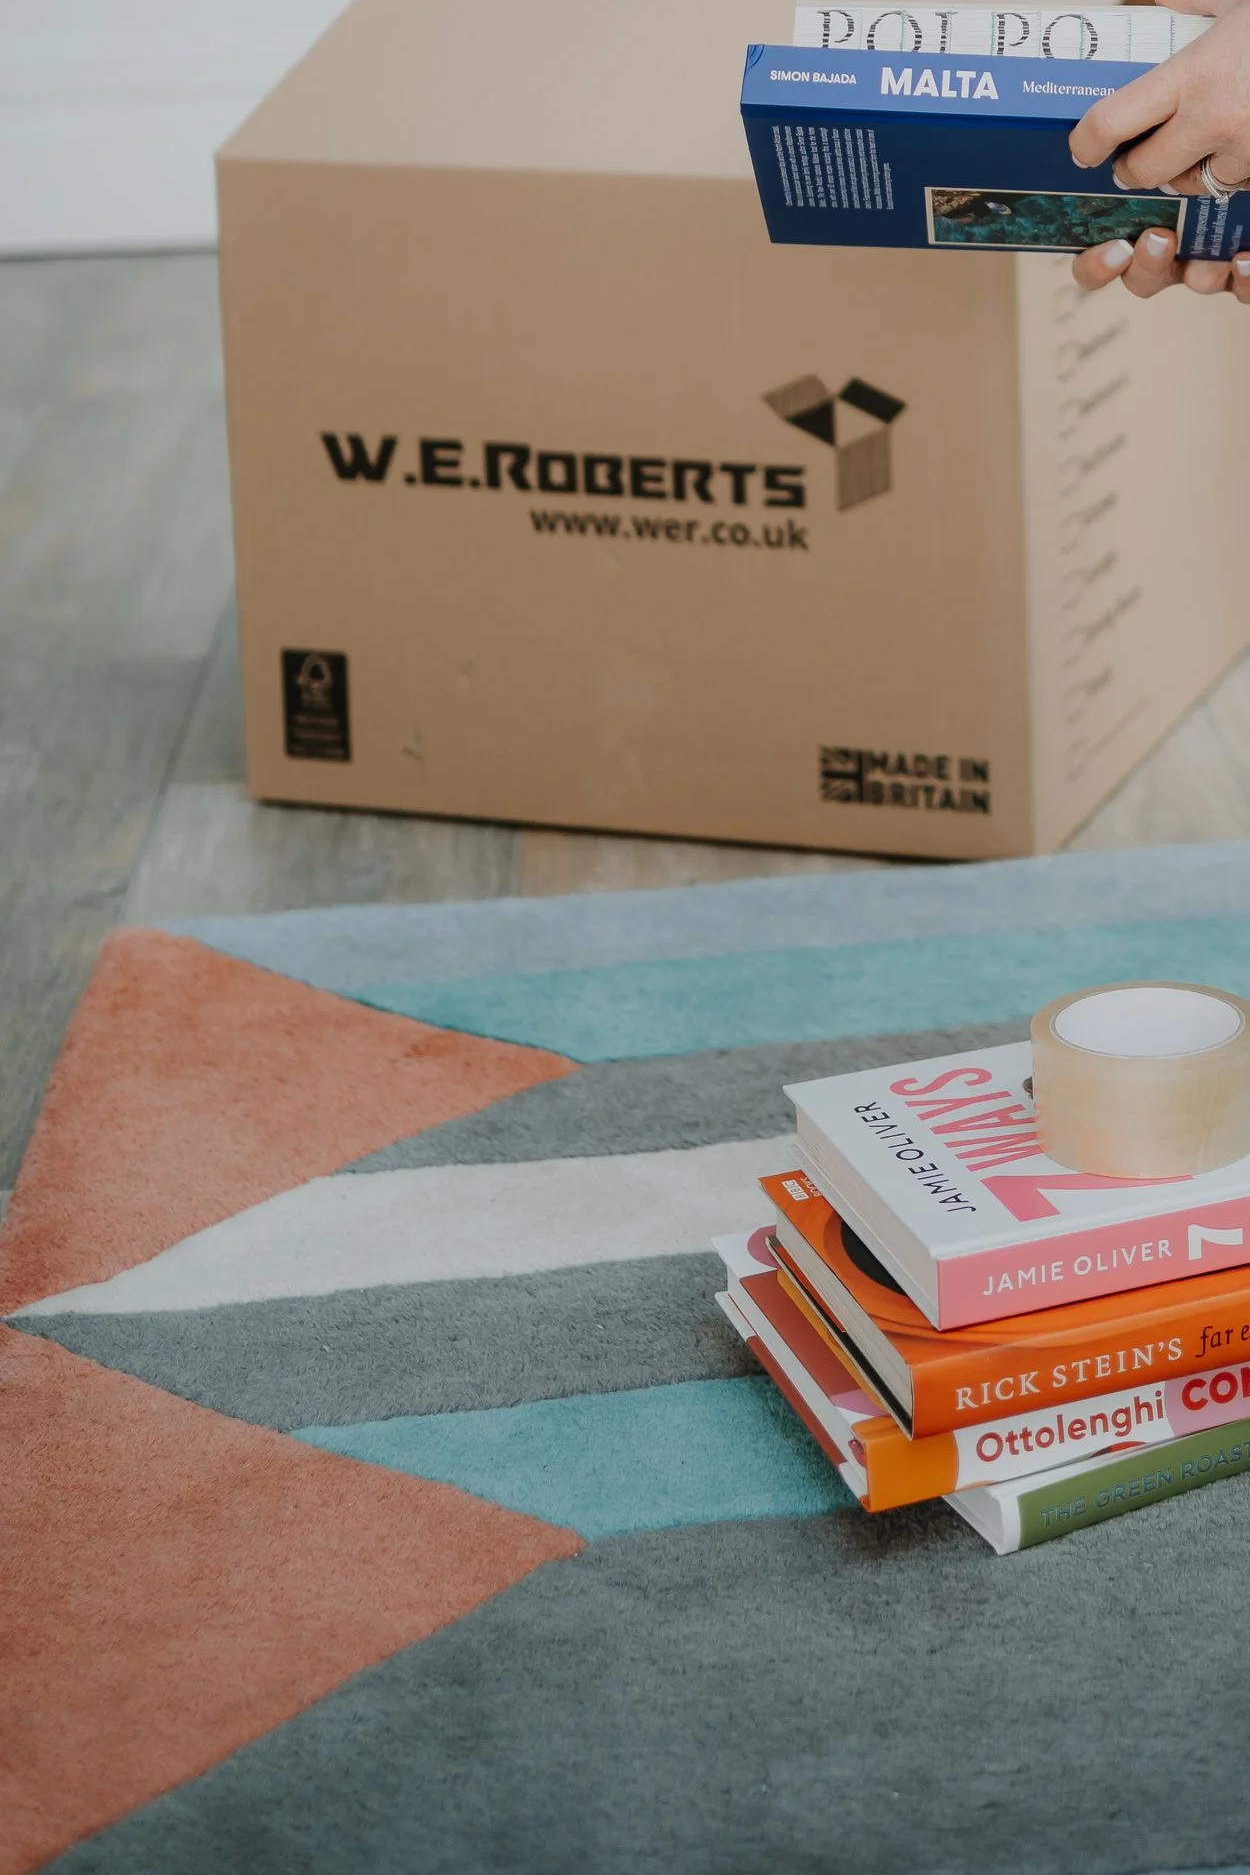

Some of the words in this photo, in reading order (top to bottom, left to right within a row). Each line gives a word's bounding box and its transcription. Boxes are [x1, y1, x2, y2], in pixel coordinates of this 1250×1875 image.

[770, 69, 809, 82] SIMON
[813, 72, 857, 85] BAJADA
[880, 66, 999, 100] MALTA
[1023, 80, 1115, 97] Mediterranean
[320, 431, 806, 509] W.E.ROBERTS
[529, 508, 810, 551] www.wer.co.uk
[862, 749, 950, 780] MADE
[959, 757, 989, 783] IN
[862, 780, 991, 815] BRITAIN
[855, 1101, 924, 1161] OLIVER
[889, 1067, 1043, 1173] WAYS
[781, 1179, 809, 1201] BBC
[909, 1161, 976, 1213] JAMIE
[982, 1261, 1064, 1297] JAMIE
[1073, 1238, 1172, 1276] OLIVER
[1187, 1224, 1243, 1260] 7
[955, 1371, 1041, 1410] RICK
[1195, 1324, 1234, 1358] far
[975, 1389, 1165, 1464] Ottolenghi
[1040, 1495, 1087, 1529] THE
[1095, 1469, 1173, 1509] GREEN
